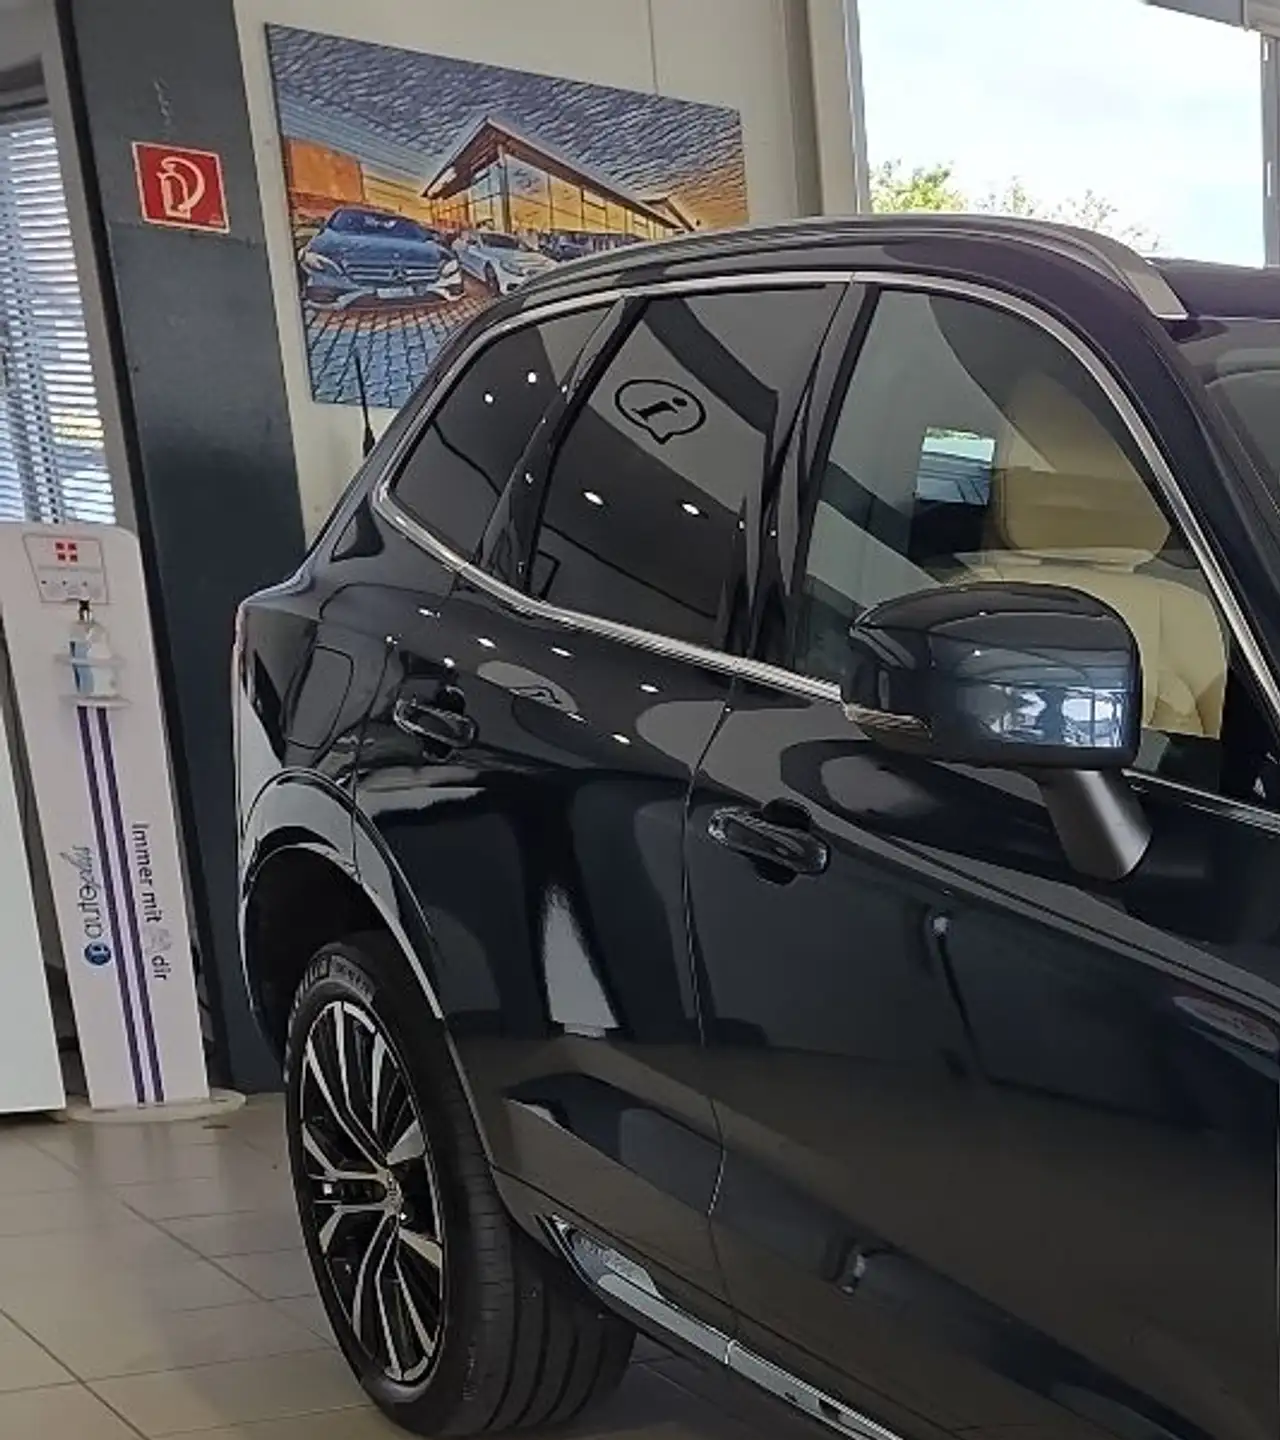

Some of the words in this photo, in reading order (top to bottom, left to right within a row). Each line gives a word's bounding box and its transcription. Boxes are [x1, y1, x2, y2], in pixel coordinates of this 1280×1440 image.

[131, 823, 154, 885] Immer
[142, 891, 163, 923] mit
[152, 955, 172, 981] dir
